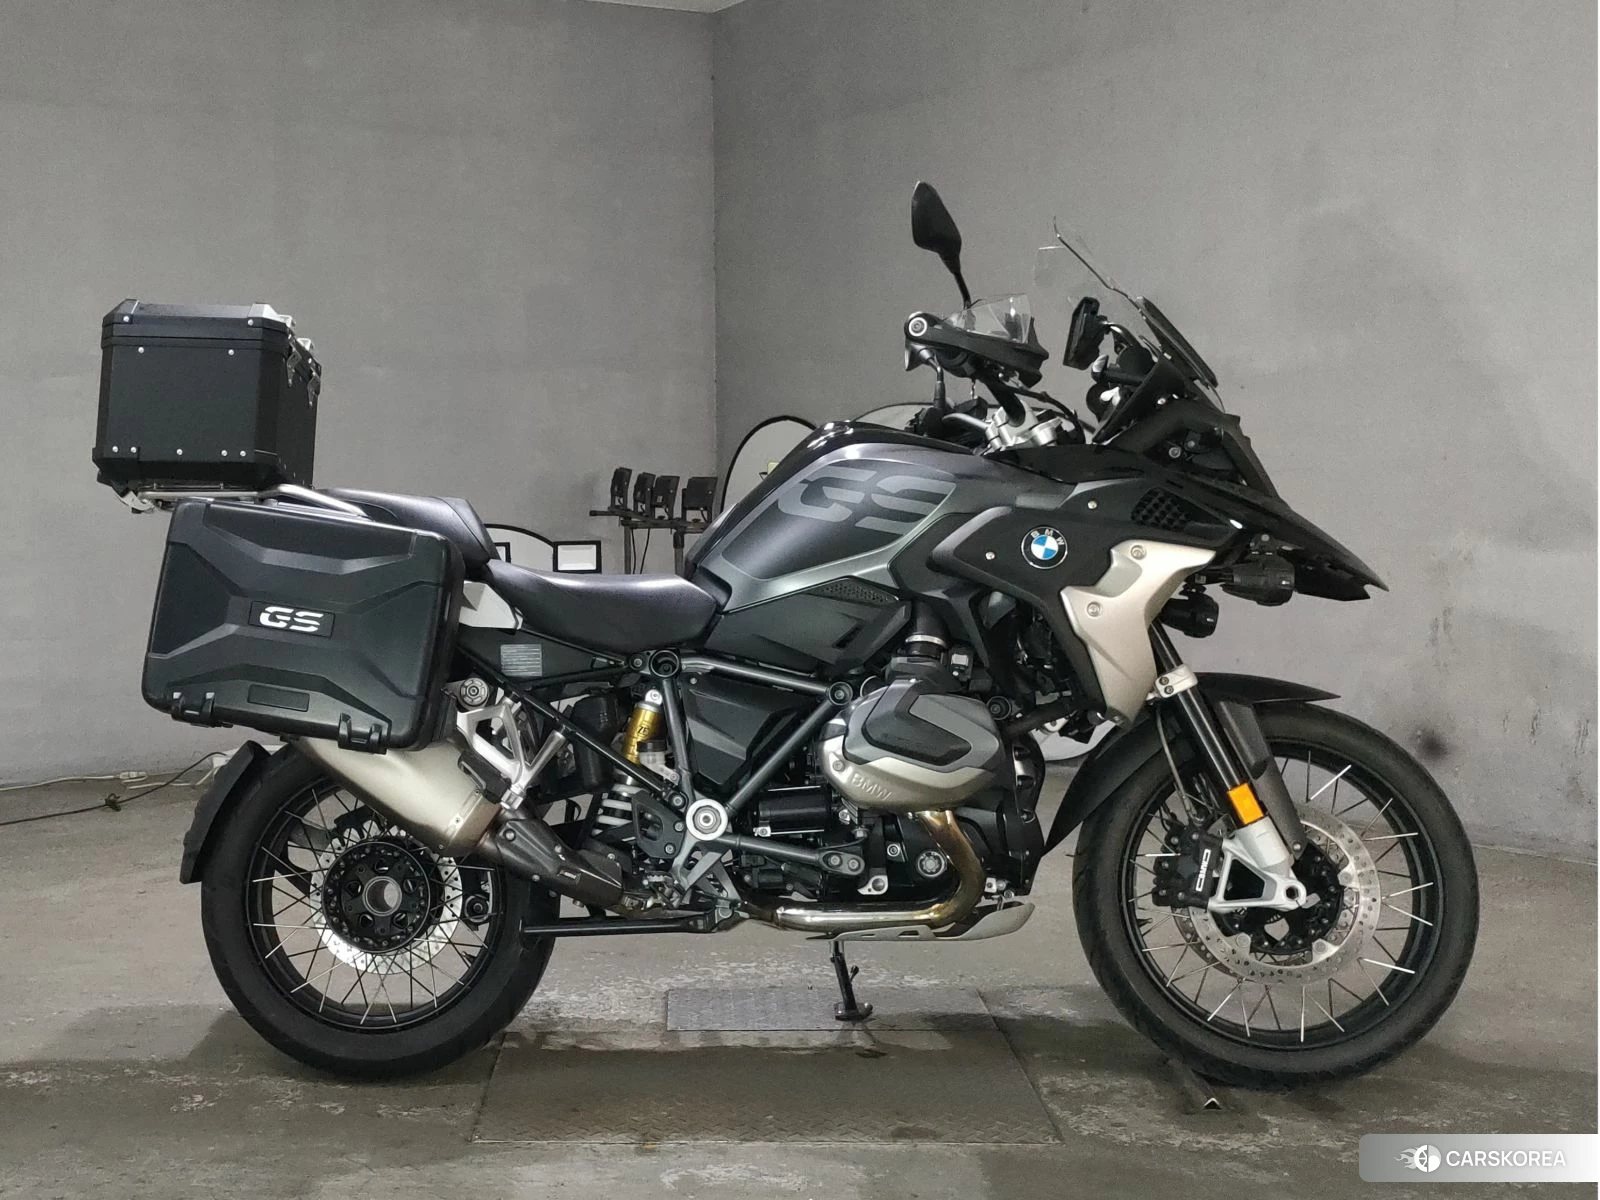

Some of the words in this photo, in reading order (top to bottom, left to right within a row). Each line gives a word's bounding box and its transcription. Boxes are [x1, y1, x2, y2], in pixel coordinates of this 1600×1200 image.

[772, 465, 956, 536] GS
[1030, 528, 1065, 546] BMW
[259, 606, 324, 632] GS
[851, 773, 895, 801] BMW
